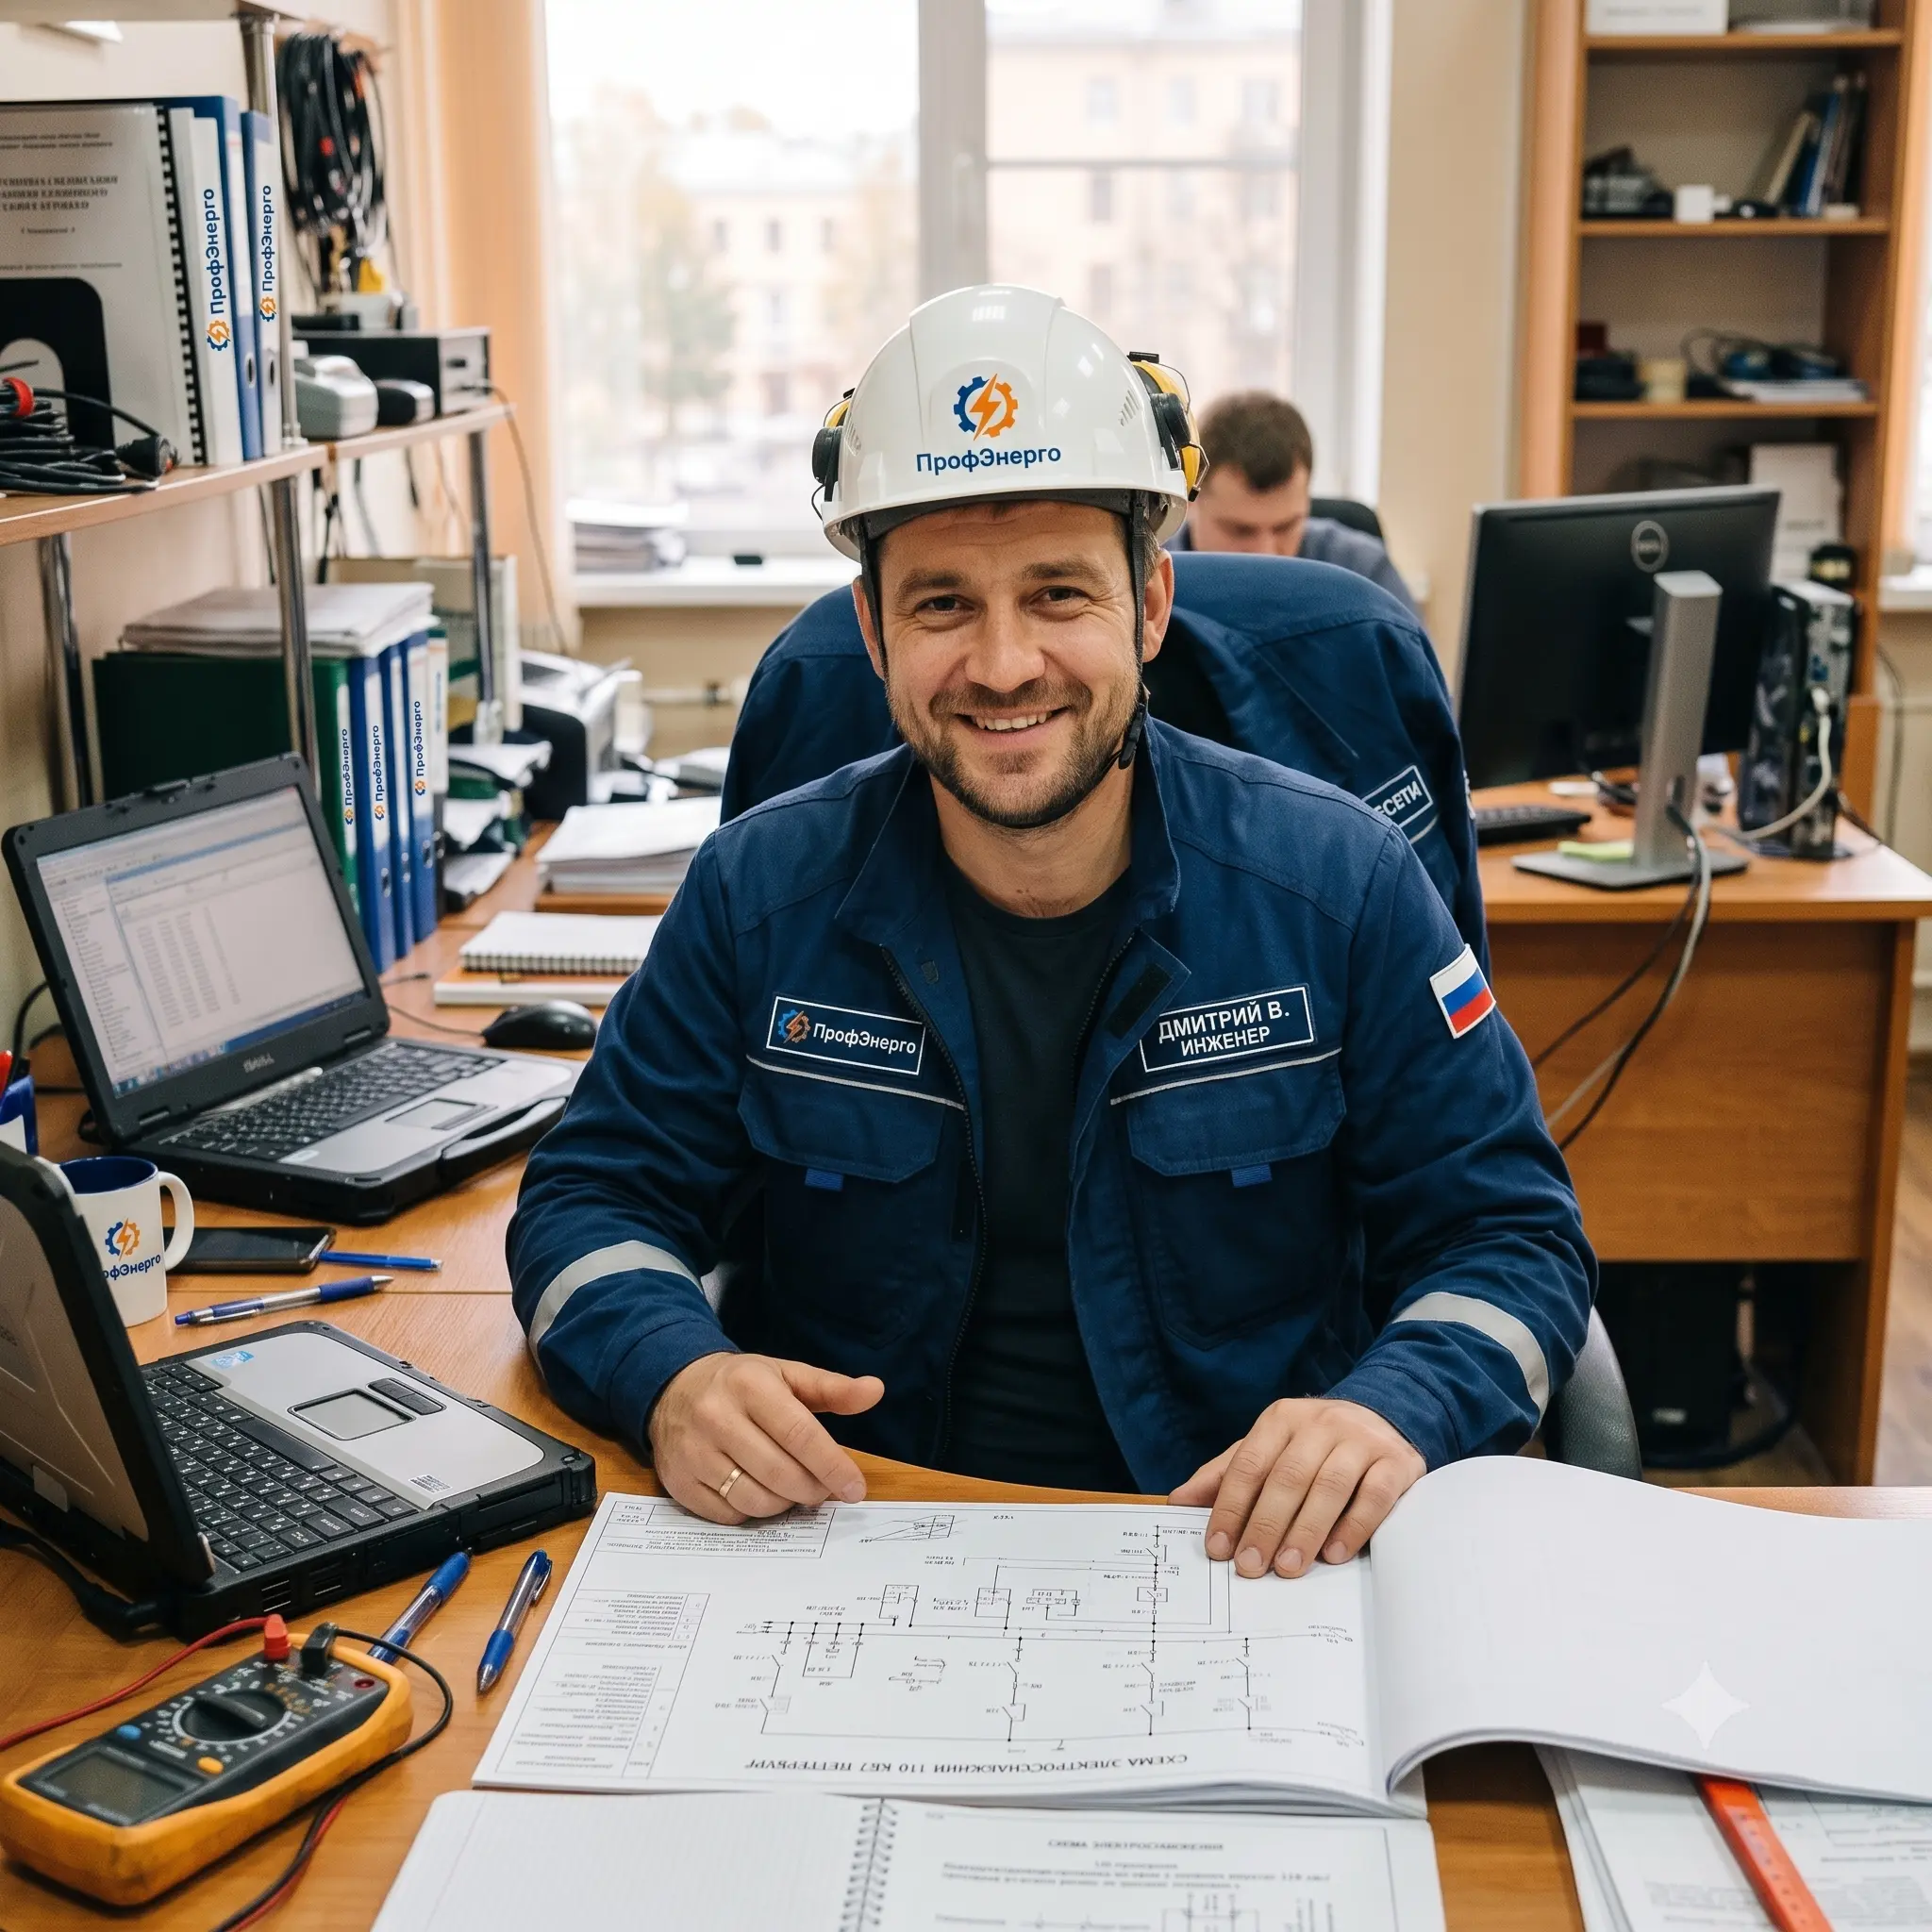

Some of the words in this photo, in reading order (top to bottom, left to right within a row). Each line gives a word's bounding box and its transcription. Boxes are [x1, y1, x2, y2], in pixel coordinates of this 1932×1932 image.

[203, 188, 227, 315] ПрофЭнерго
[260, 185, 275, 291] ПрофЭнерго
[916, 447, 1061, 475] ПрофЭнерго
[1158, 1000, 1262, 1044] ДМИТРИЙ
[1267, 1001, 1291, 1020] В.
[813, 1024, 916, 1055] ПрофЭнерго
[1181, 1025, 1271, 1057] ИНЖЕНЕР
[103, 1255, 161, 1280] офЭнерго
